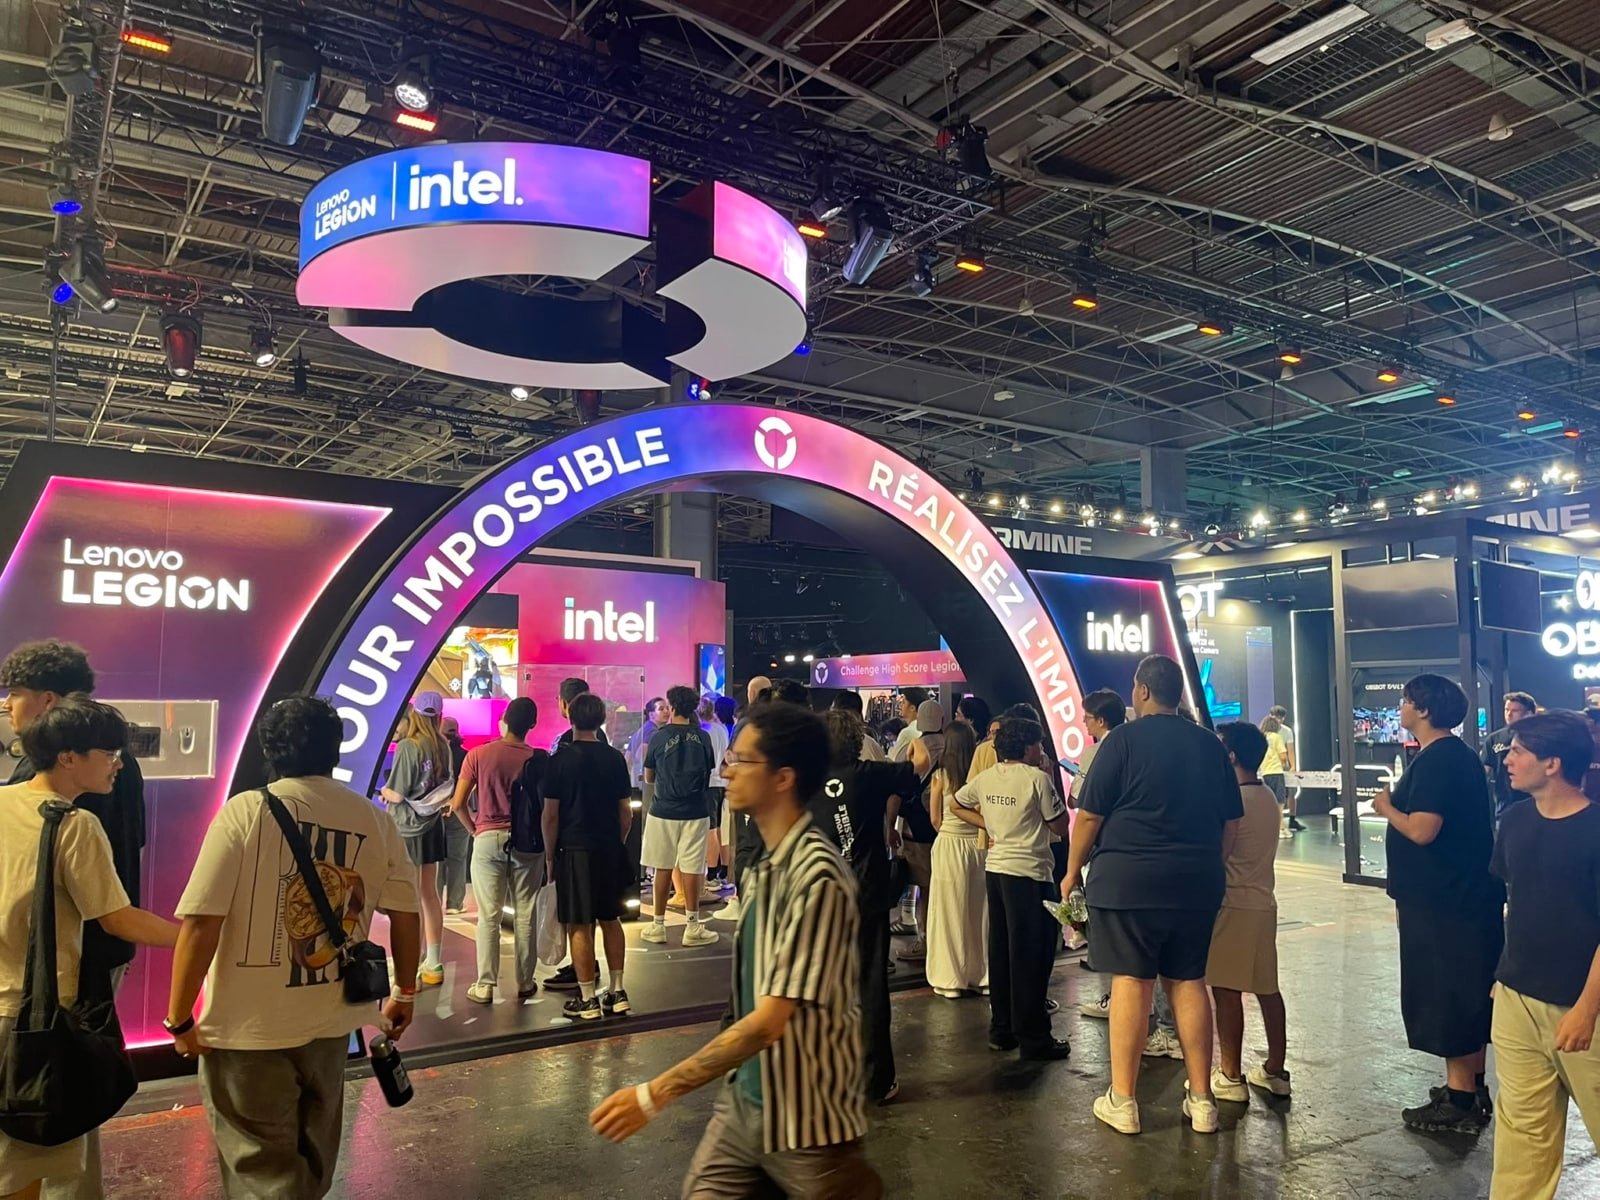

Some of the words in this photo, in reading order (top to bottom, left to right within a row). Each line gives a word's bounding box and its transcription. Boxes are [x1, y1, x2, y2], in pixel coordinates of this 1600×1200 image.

[315, 195, 376, 241] LEGION
[316, 188, 350, 217] Lenovo
[63, 538, 184, 571] Lenovo
[868, 460, 1024, 617] RÉALISEZ
[61, 569, 250, 612] LEGION
[332, 625, 416, 783] OUR
[391, 427, 670, 626] IMPOSSIBLE
[563, 597, 656, 643] intel
[1086, 611, 1151, 653] intel
[840, 664, 880, 677] Challenge
[881, 663, 901, 674] High
[903, 662, 928, 673] Score
[986, 795, 1017, 806] METEOR
